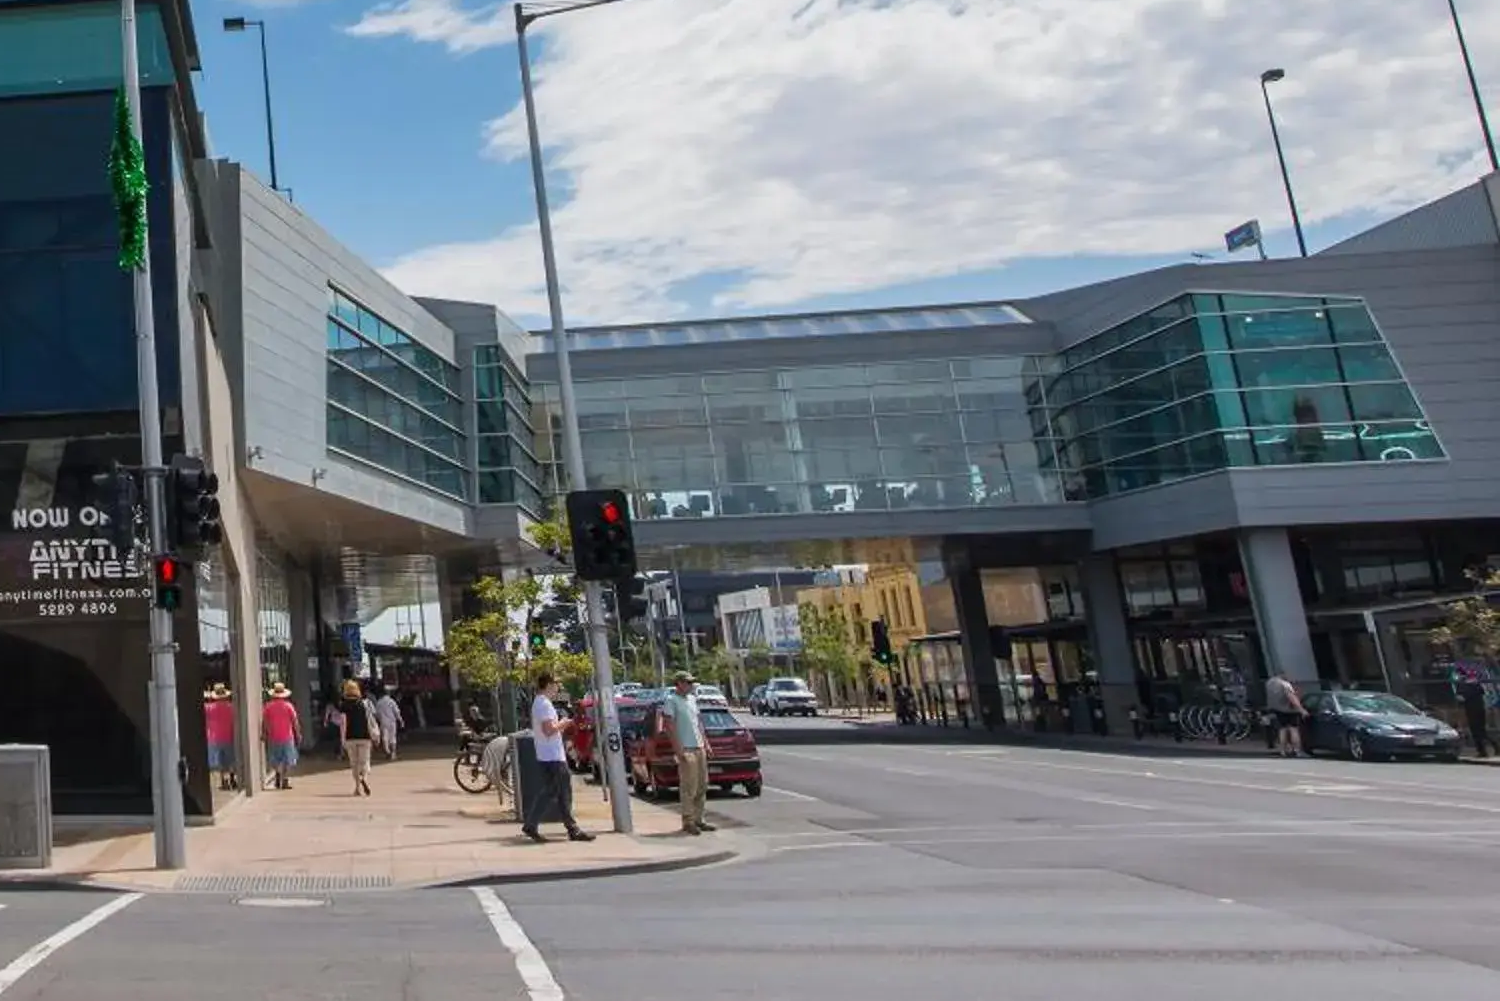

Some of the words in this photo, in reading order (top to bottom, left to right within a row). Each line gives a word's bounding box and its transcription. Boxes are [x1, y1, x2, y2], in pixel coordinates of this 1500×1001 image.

[12, 507, 69, 529] NOW
[29, 538, 150, 562] ANYTI
[32, 560, 145, 580] FITNES
